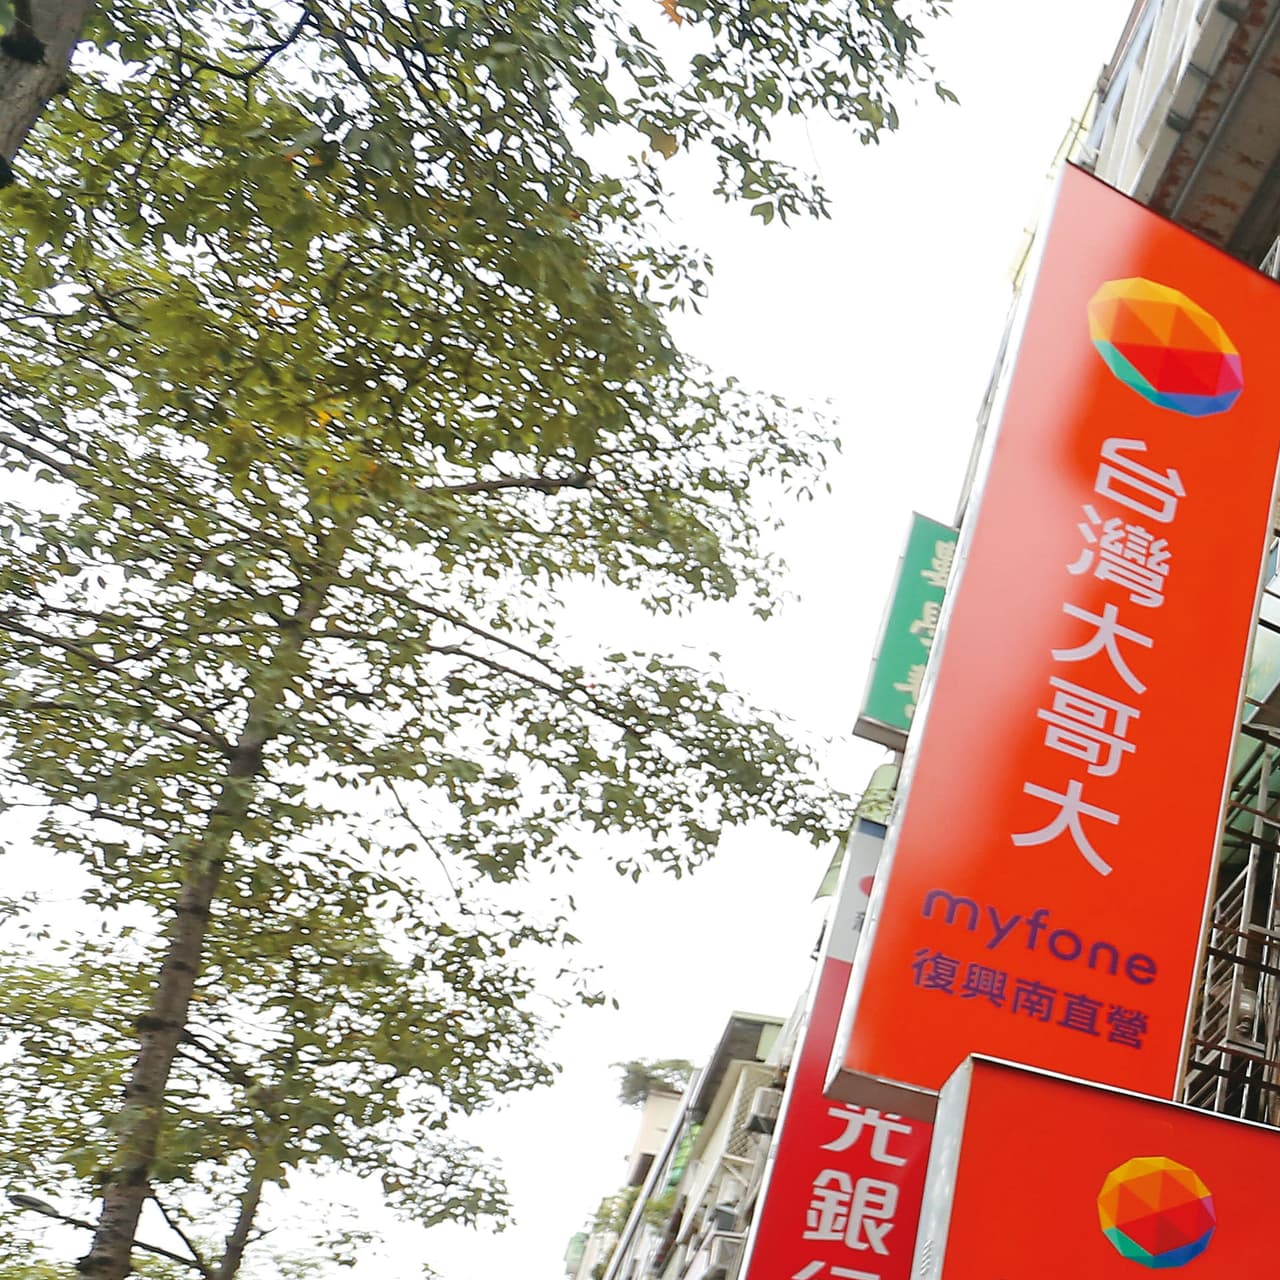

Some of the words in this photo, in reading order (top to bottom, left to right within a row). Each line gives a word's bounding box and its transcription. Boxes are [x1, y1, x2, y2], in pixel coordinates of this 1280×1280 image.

[1009, 436, 1188, 878] 台灣大哥大
[922, 886, 1159, 987] myfone
[909, 947, 1149, 1052] 復興南直營
